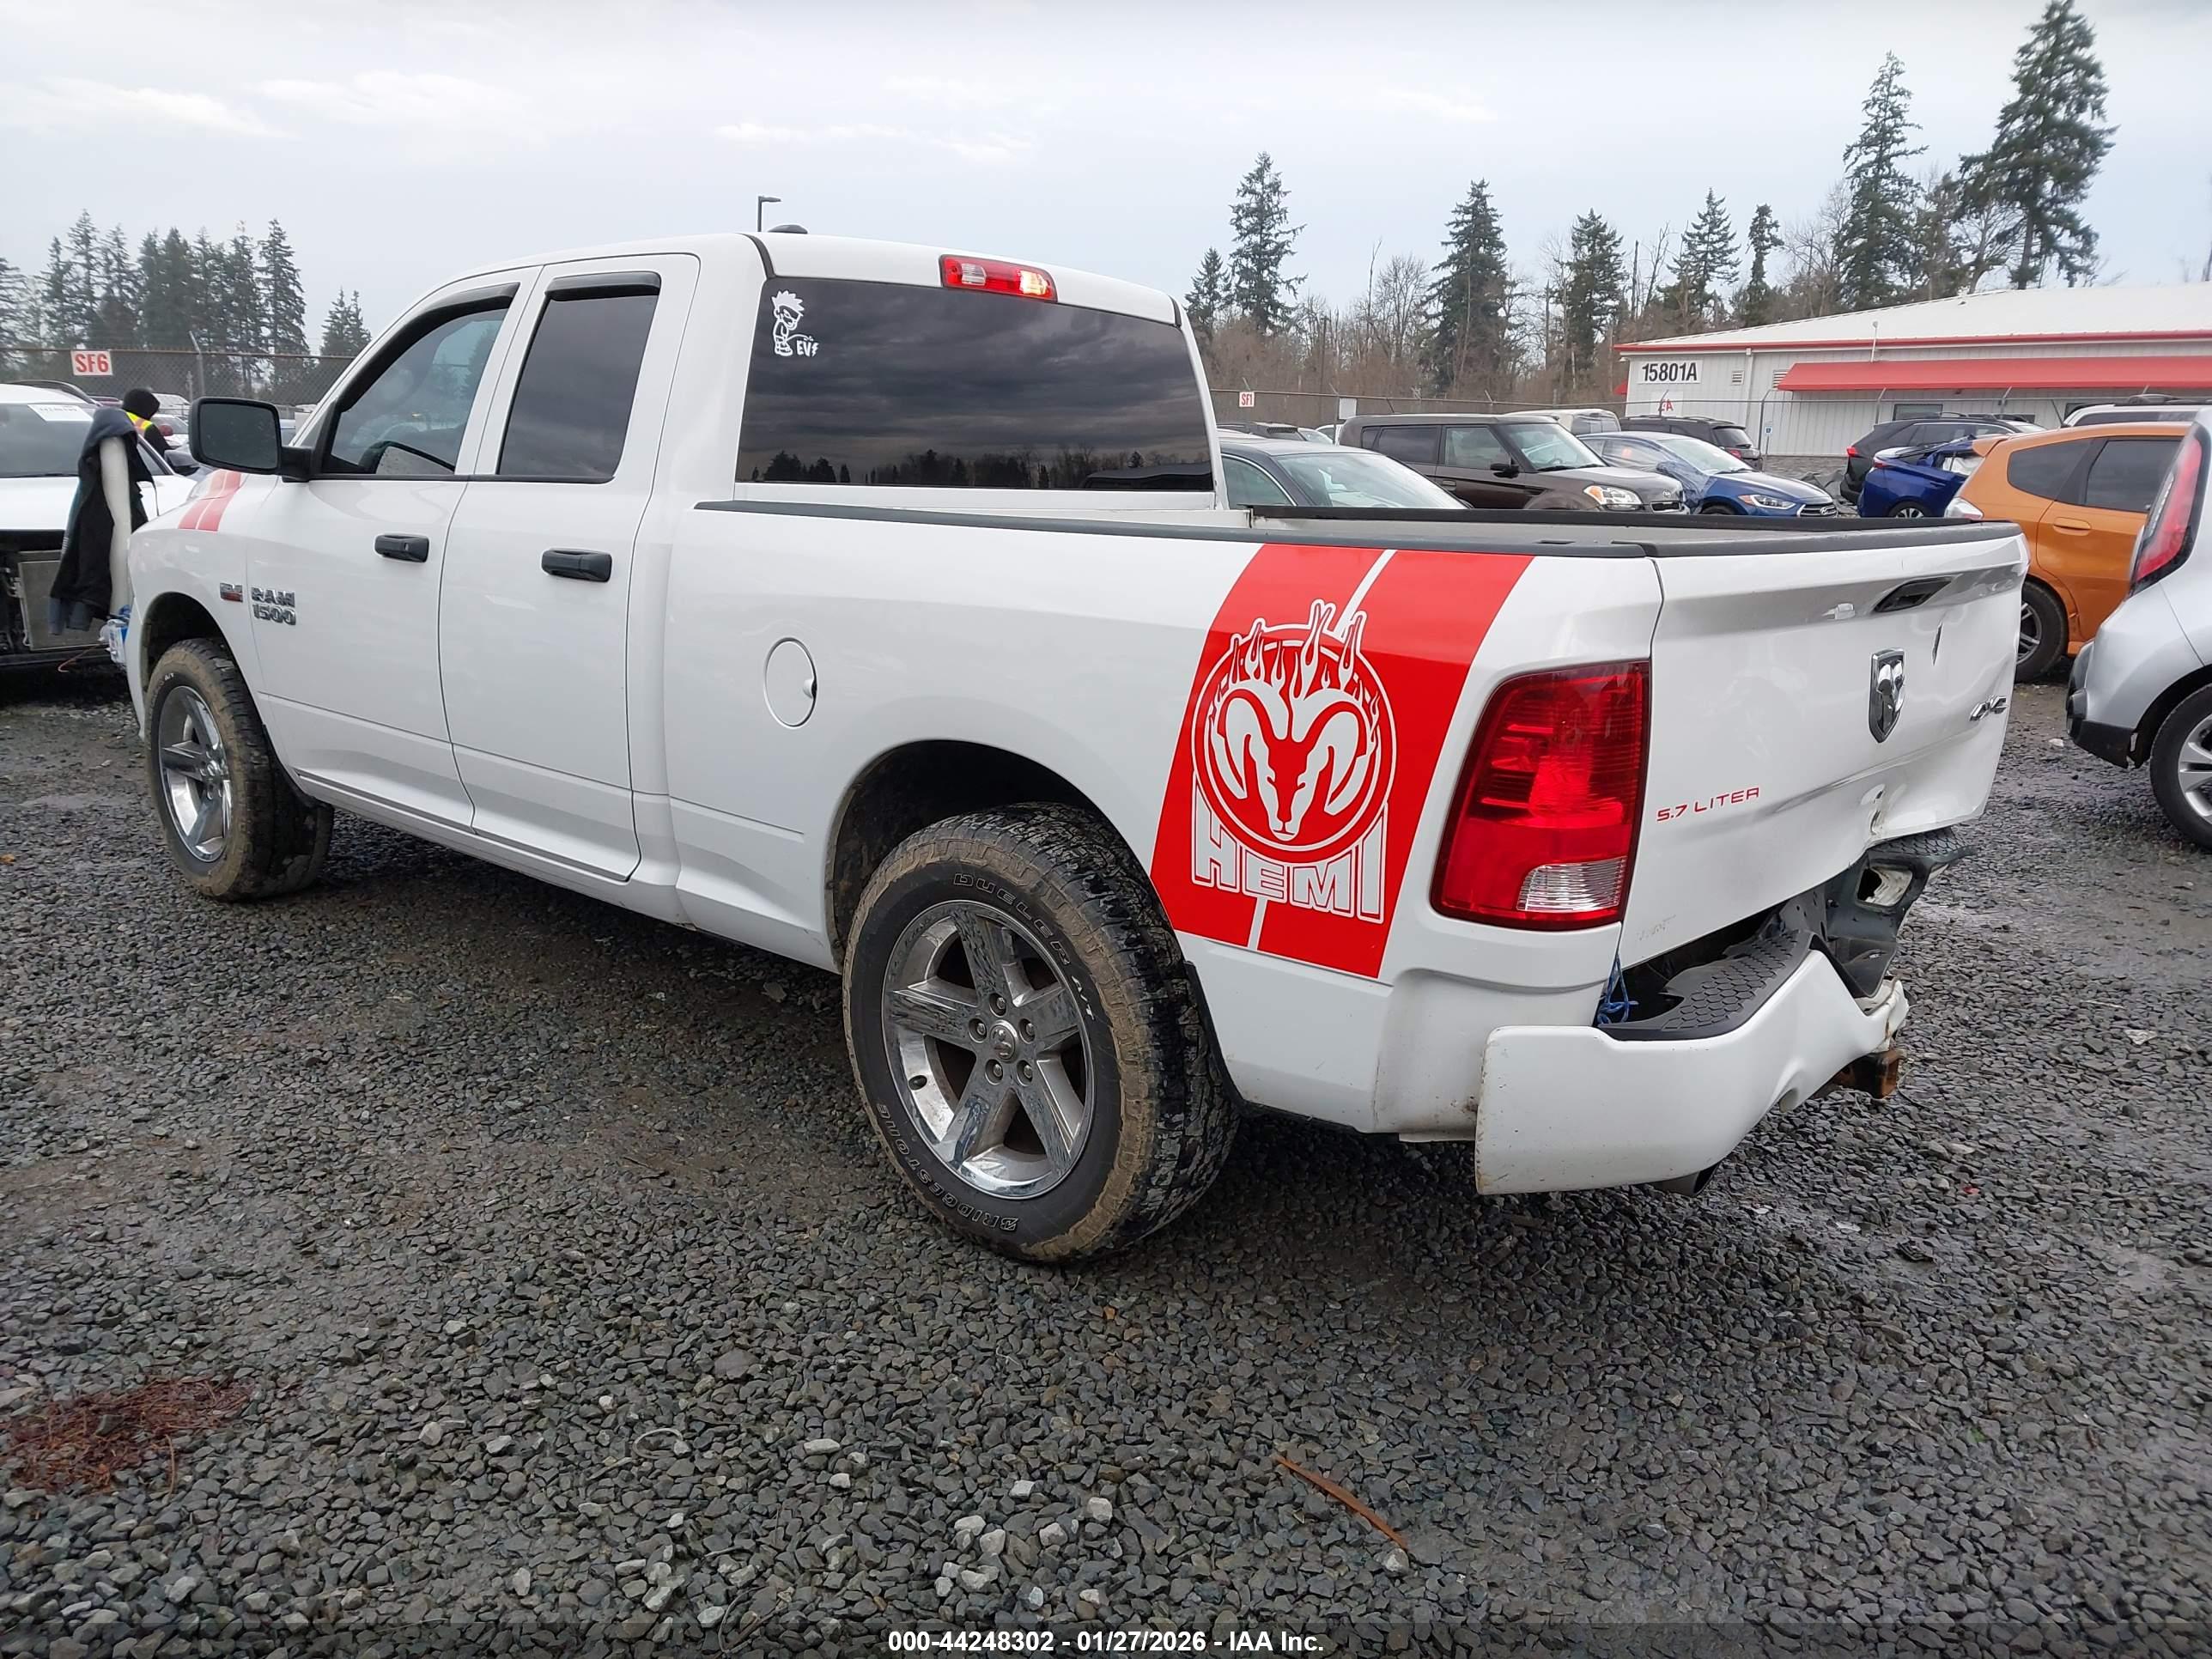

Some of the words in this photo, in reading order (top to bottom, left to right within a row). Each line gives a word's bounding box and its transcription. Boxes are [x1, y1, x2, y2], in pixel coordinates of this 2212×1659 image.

[74, 353, 110, 373] SF6
[1641, 362, 1698, 382] 15801A
[251, 586, 295, 608] RAM
[252, 603, 296, 626] 1500
[1656, 804, 1688, 822] 5.7
[1693, 787, 1759, 813] LITER
[1191, 770, 1389, 925] HEMI
[953, 872, 1071, 966] DUELER
[876, 1103, 1019, 1231] BRIDGESTONE
